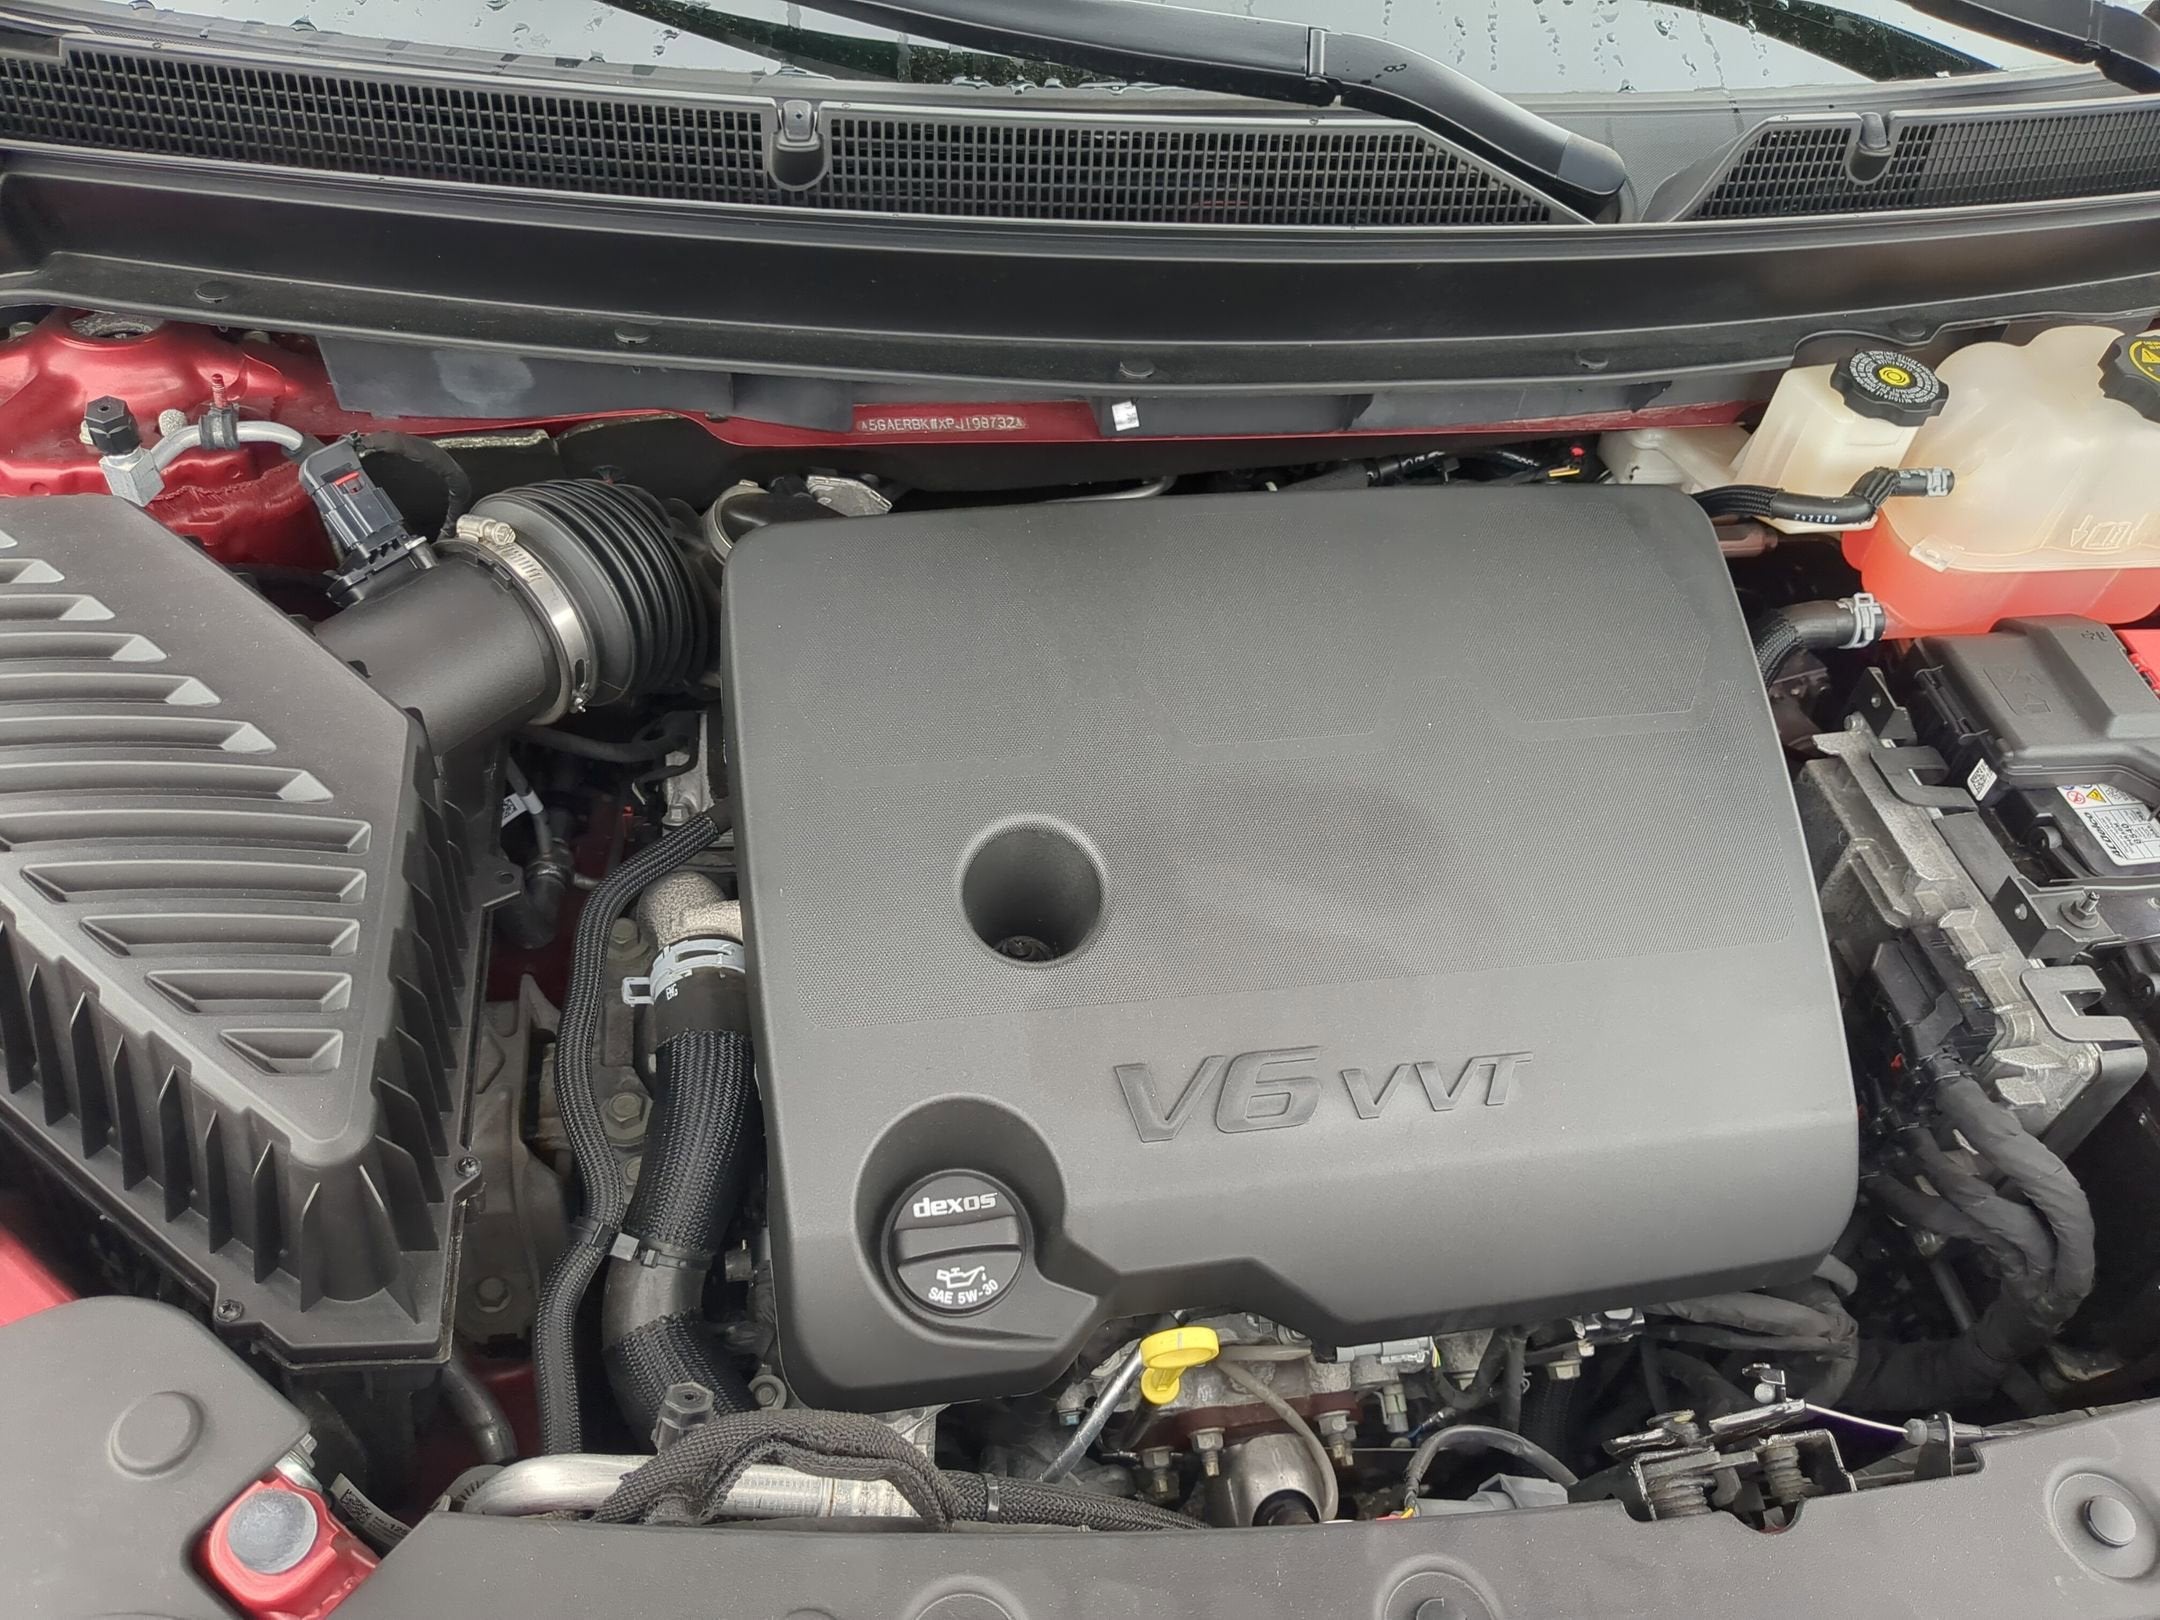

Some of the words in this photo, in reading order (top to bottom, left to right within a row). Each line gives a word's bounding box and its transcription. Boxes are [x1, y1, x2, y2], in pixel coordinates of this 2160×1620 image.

[1113, 1045, 1323, 1143] V6
[1341, 1051, 1533, 1119] VVT
[912, 1192, 998, 1218] dexos
[928, 1287, 953, 1304] SAE
[958, 1279, 998, 1304] 5W-30
